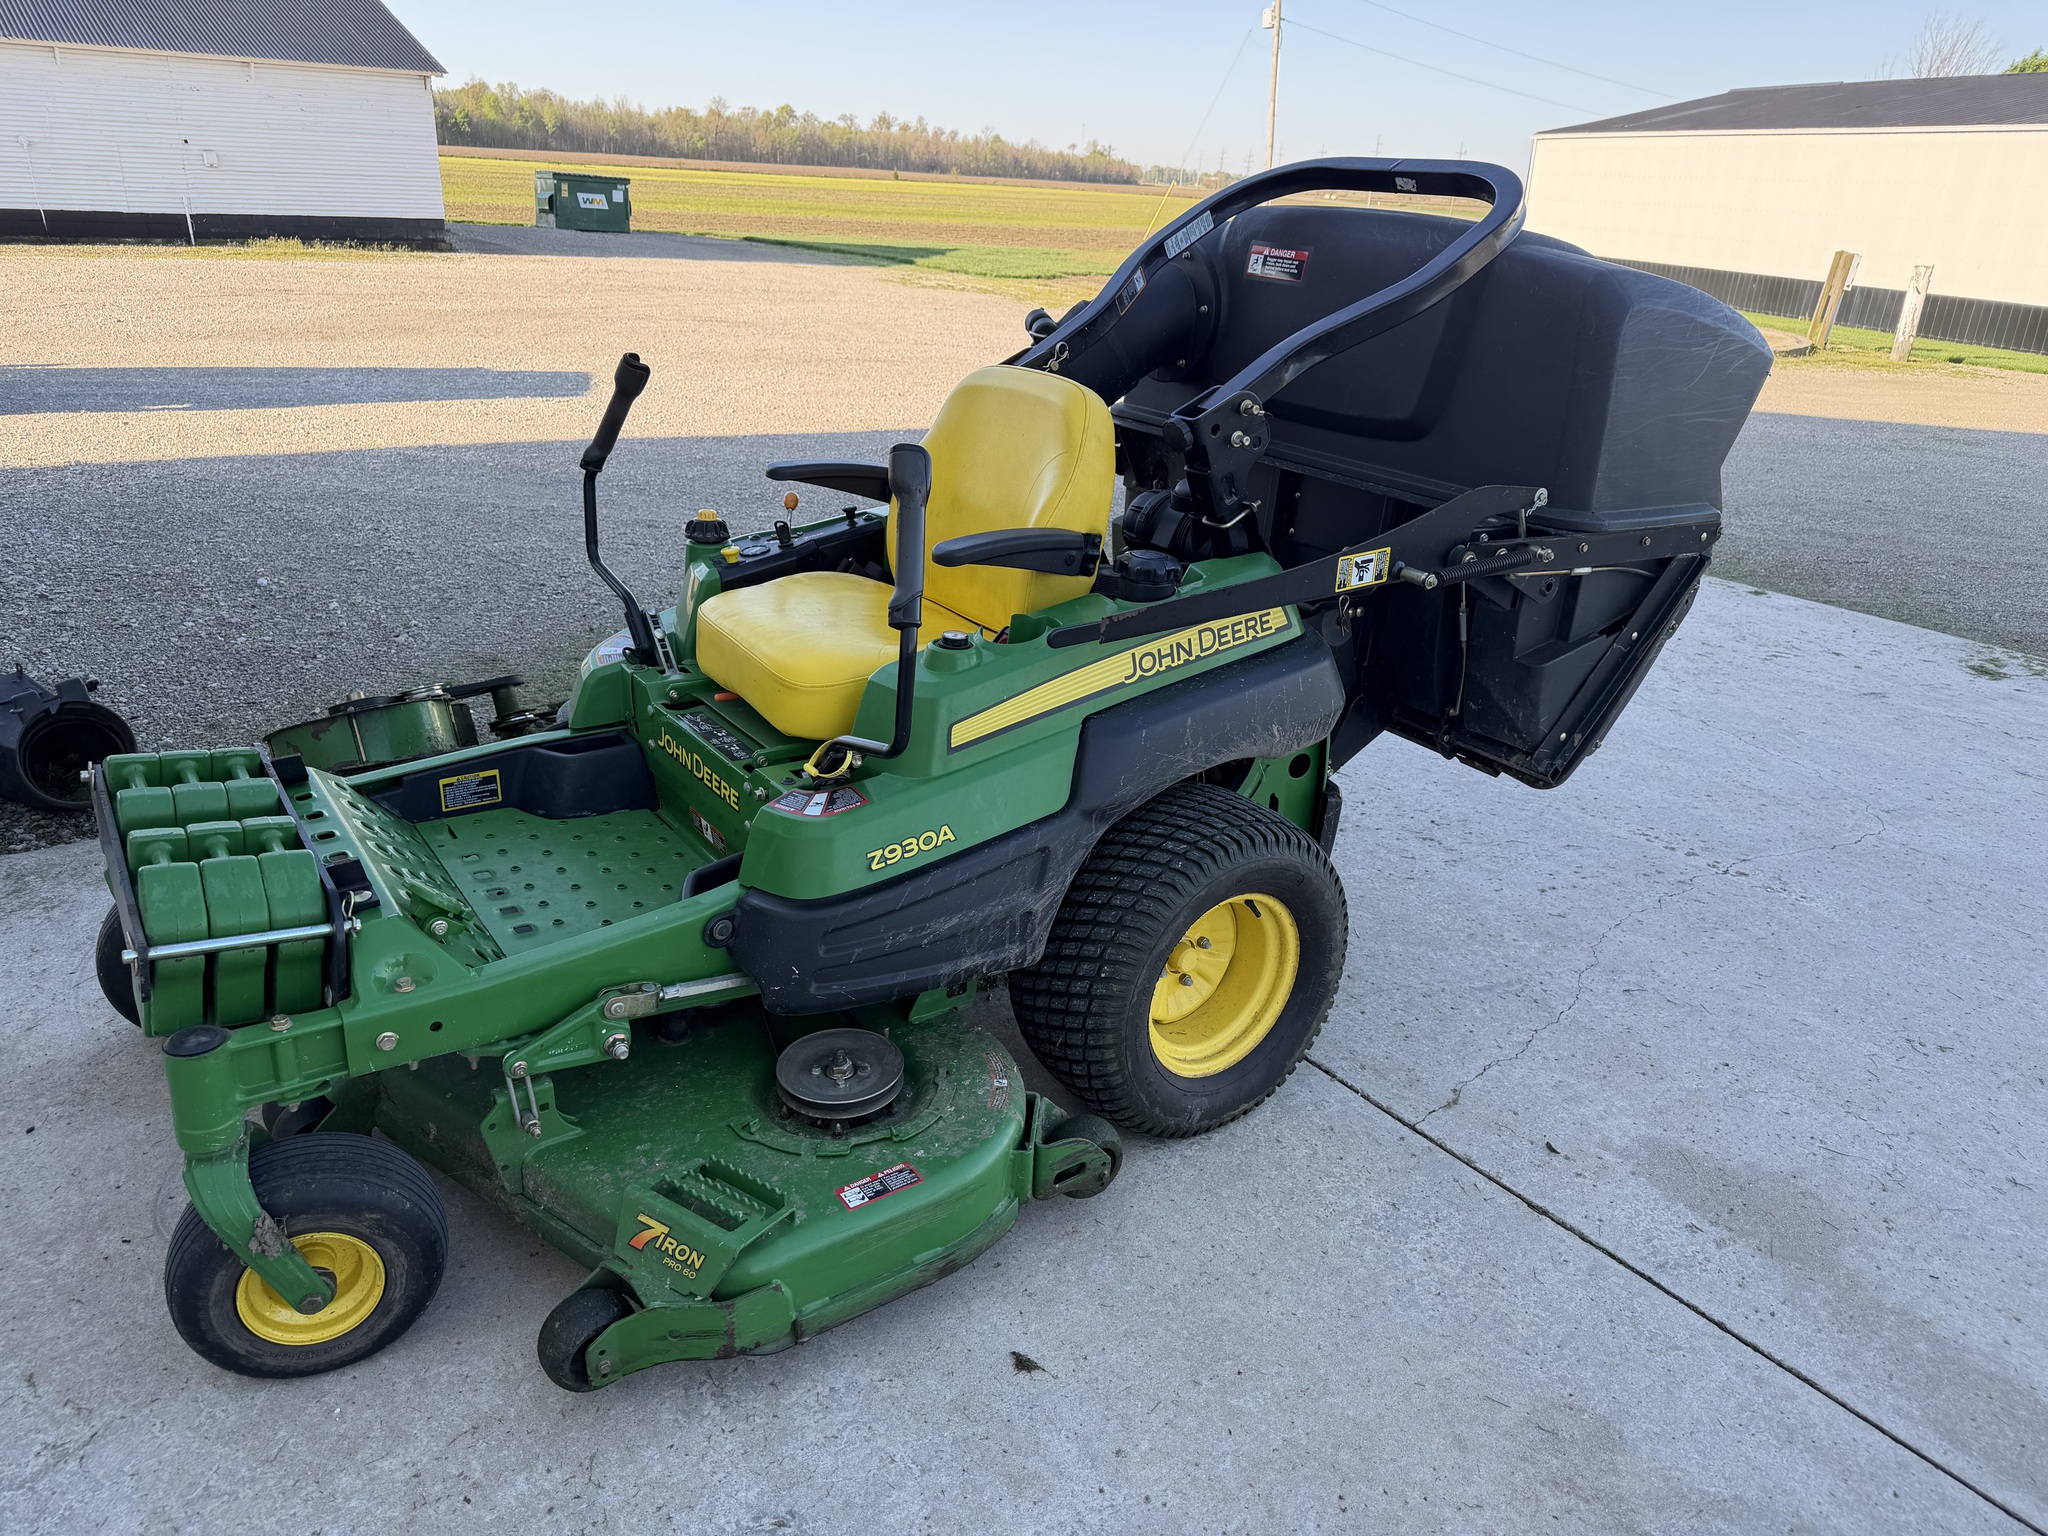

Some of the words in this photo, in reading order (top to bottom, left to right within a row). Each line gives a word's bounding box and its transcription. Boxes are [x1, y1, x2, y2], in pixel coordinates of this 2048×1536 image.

[582, 197, 604, 206] WM
[1270, 249, 1296, 258] DANGER
[1124, 636, 1194, 683] JOHN
[1197, 612, 1274, 657] DEERE
[657, 726, 692, 771] JOHN
[693, 752, 740, 812] DEERE
[866, 824, 957, 871] Z930A
[849, 1177, 872, 1189] DANGER
[883, 1163, 905, 1175] PELIGRO
[662, 1257, 682, 1272] PRO
[682, 1268, 697, 1279] 60
